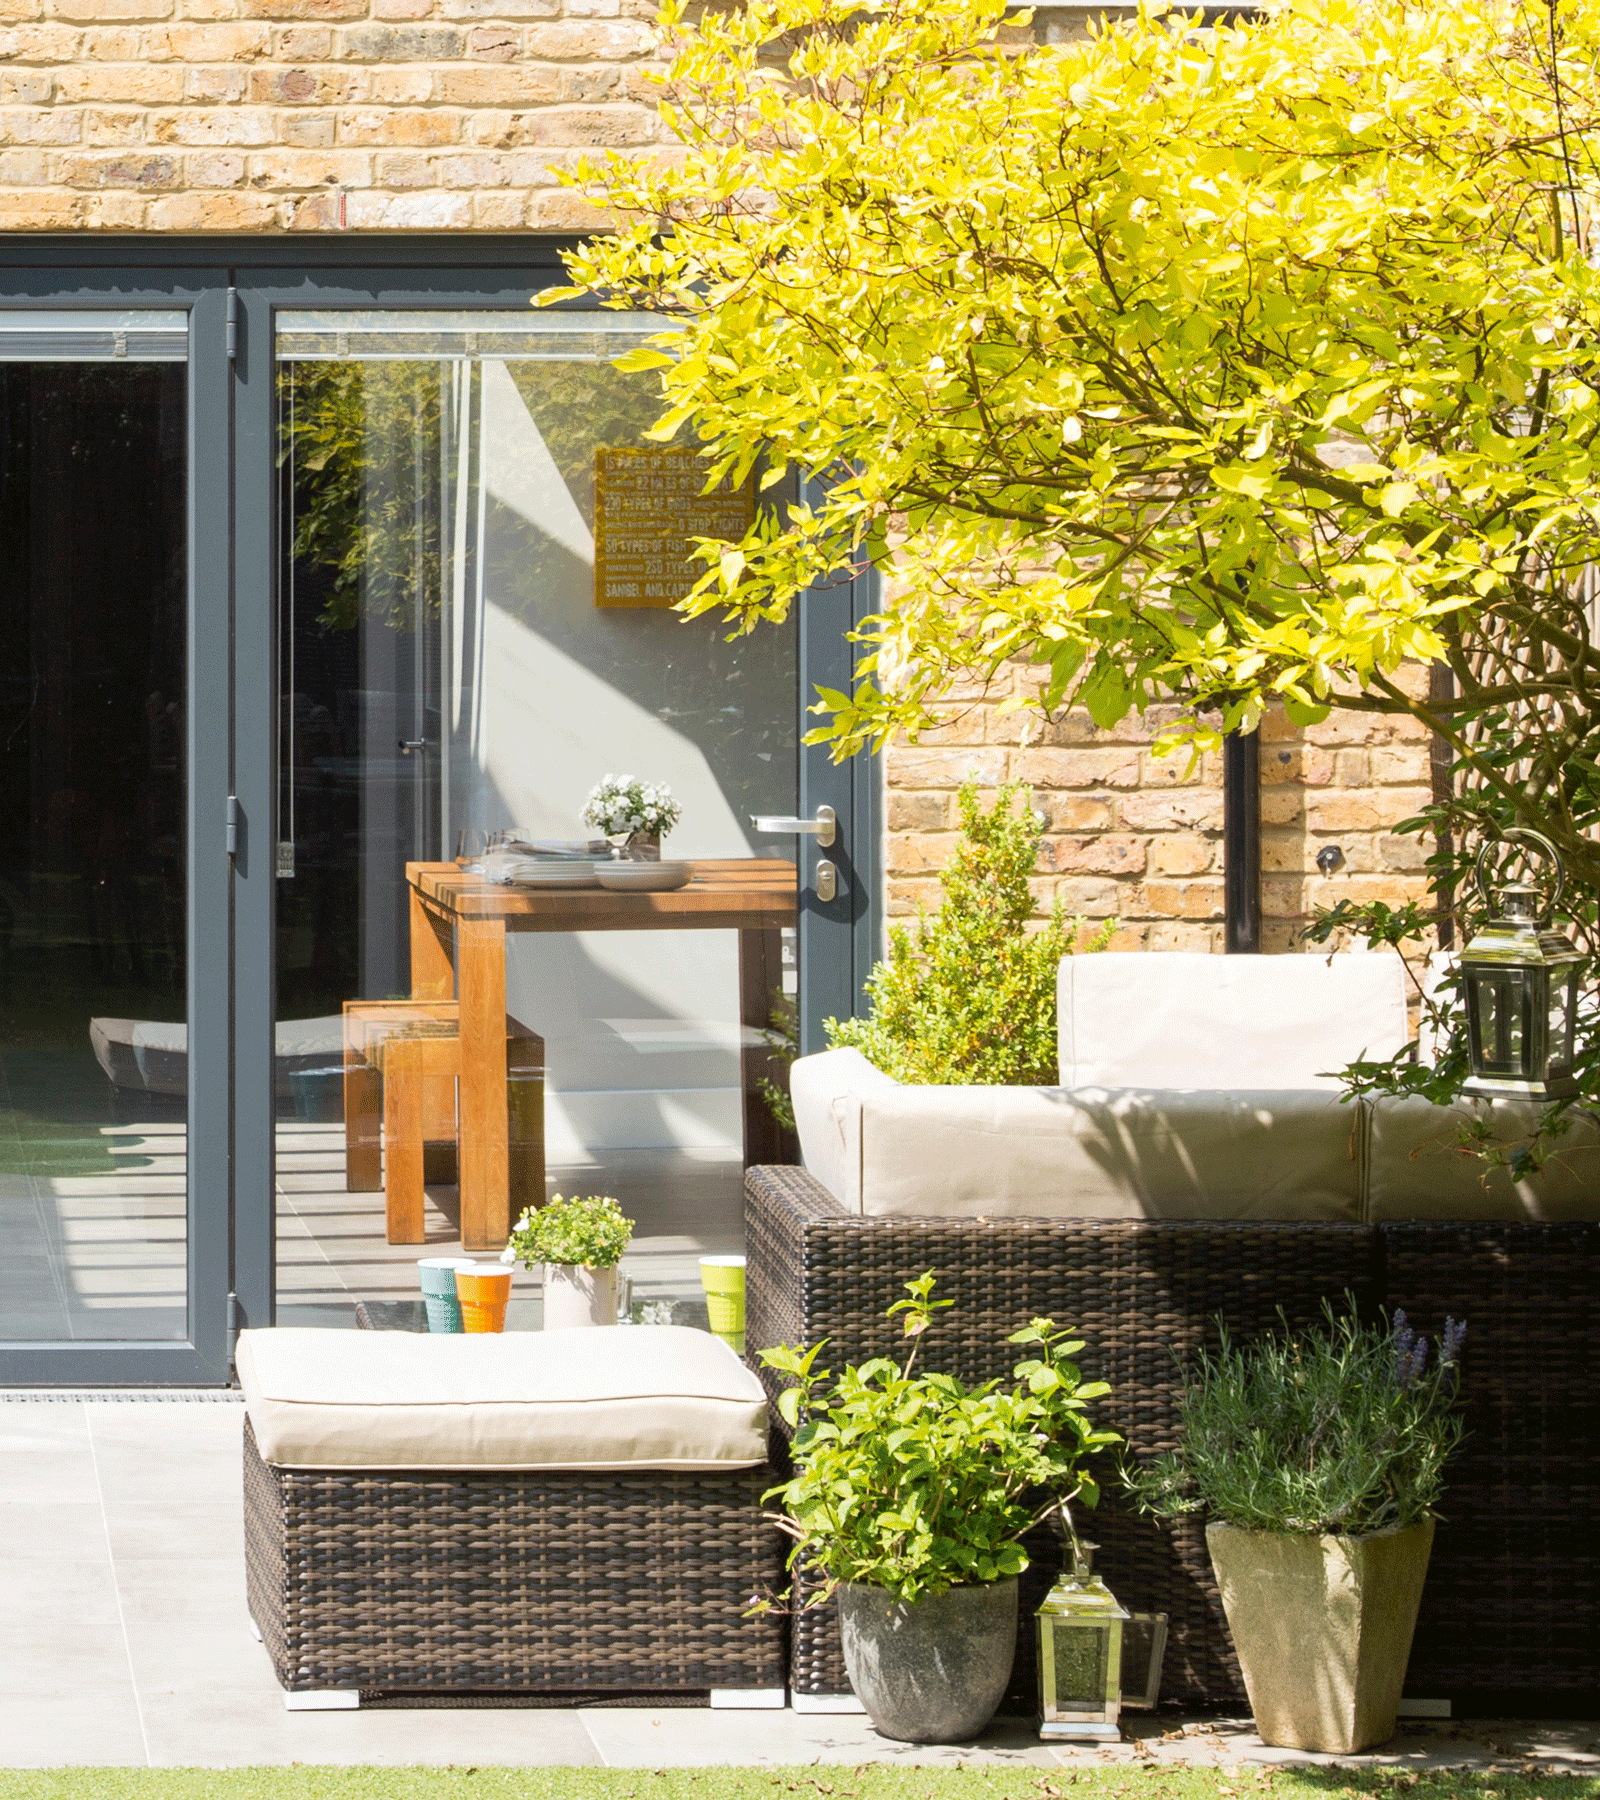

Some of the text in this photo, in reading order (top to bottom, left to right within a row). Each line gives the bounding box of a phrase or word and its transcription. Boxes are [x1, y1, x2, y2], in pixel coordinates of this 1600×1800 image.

[649, 456, 663, 469] OF
[665, 456, 710, 469] BEACHES
[636, 477, 649, 490] 22
[679, 477, 692, 490] OF
[623, 497, 651, 510] TYPES
[652, 497, 665, 510] OF
[687, 518, 711, 531] STOP
[713, 518, 745, 531] LIGHTS
[604, 539, 618, 553] 50
[620, 539, 649, 553] TYPES
[651, 539, 663, 553] OF
[665, 539, 687, 553] FISH
[644, 560, 662, 574] 250
[664, 560, 695, 574] TYPES
[644, 583, 664, 597] AND
